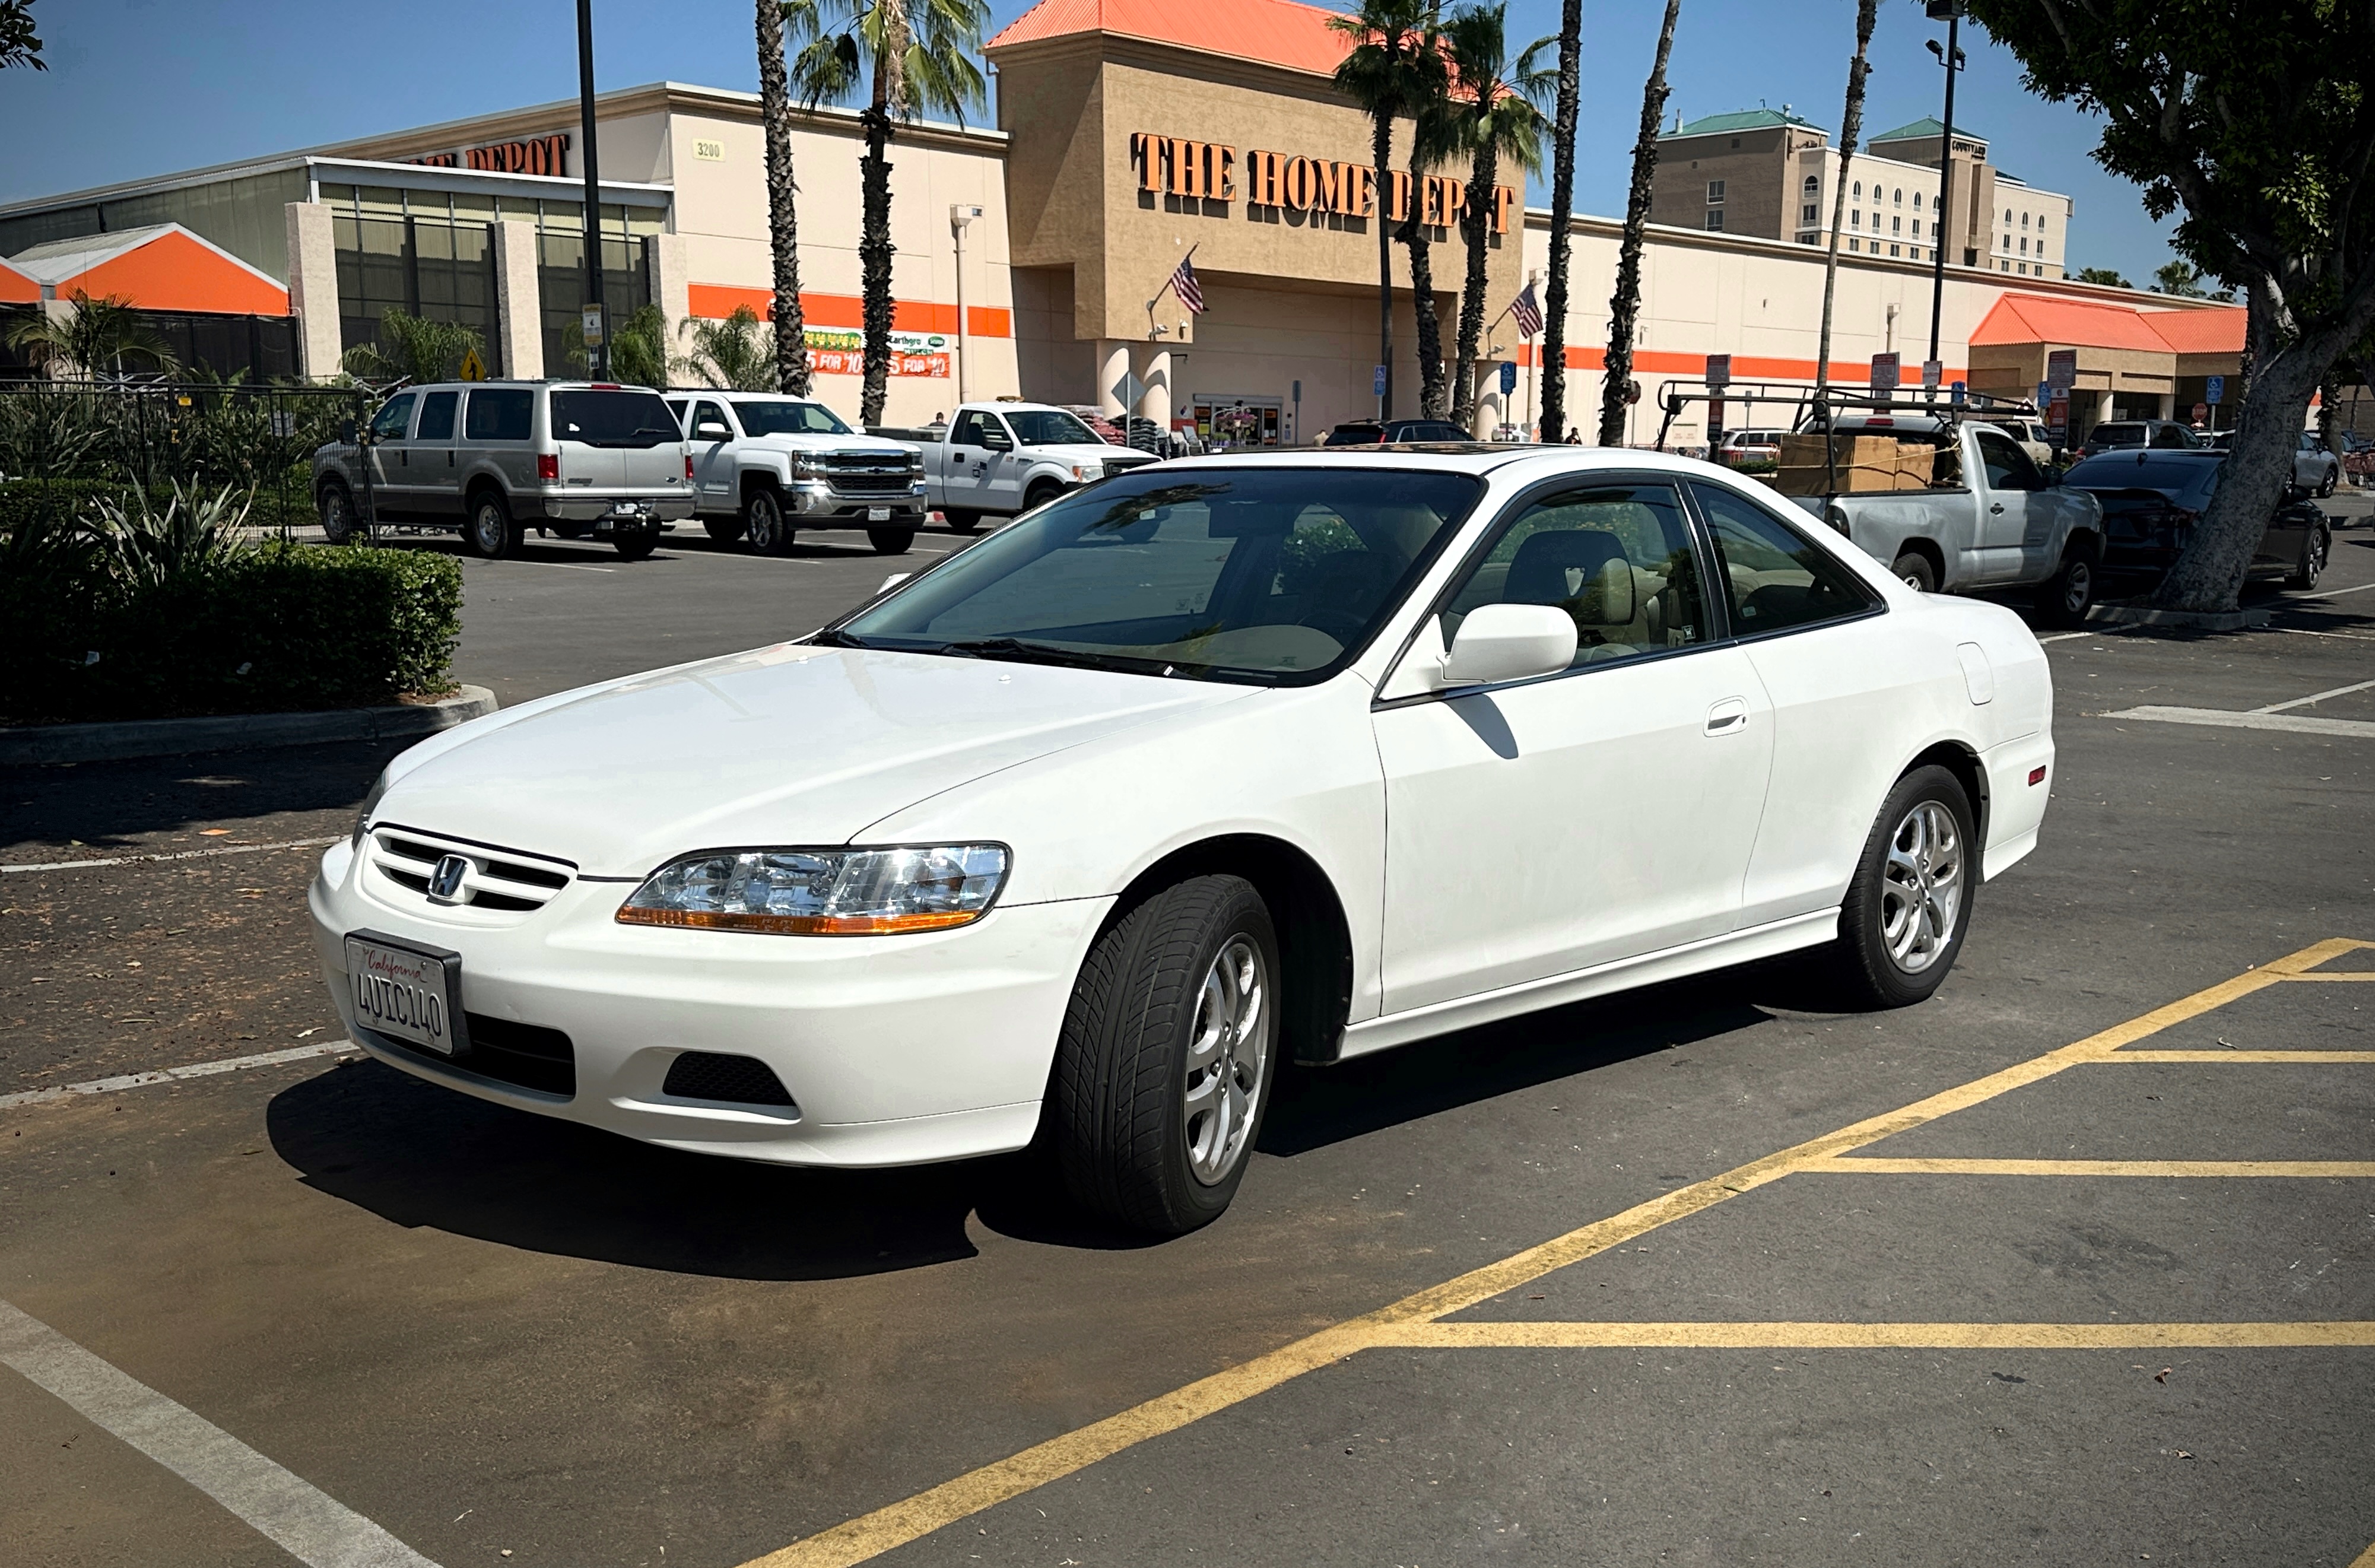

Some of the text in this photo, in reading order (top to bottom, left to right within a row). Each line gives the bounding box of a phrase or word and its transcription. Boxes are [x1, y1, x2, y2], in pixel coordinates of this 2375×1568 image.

[466, 134, 570, 177] DEPOT
[697, 142, 720, 158] 3200
[1131, 132, 1515, 234] THE HOME DEPT
[805, 350, 817, 370] 5
[819, 354, 842, 370] FOR
[887, 356, 900, 374] 5
[904, 359, 925, 373] FOR
[368, 950, 428, 983] California
[358, 973, 443, 1037] 4UIC140
